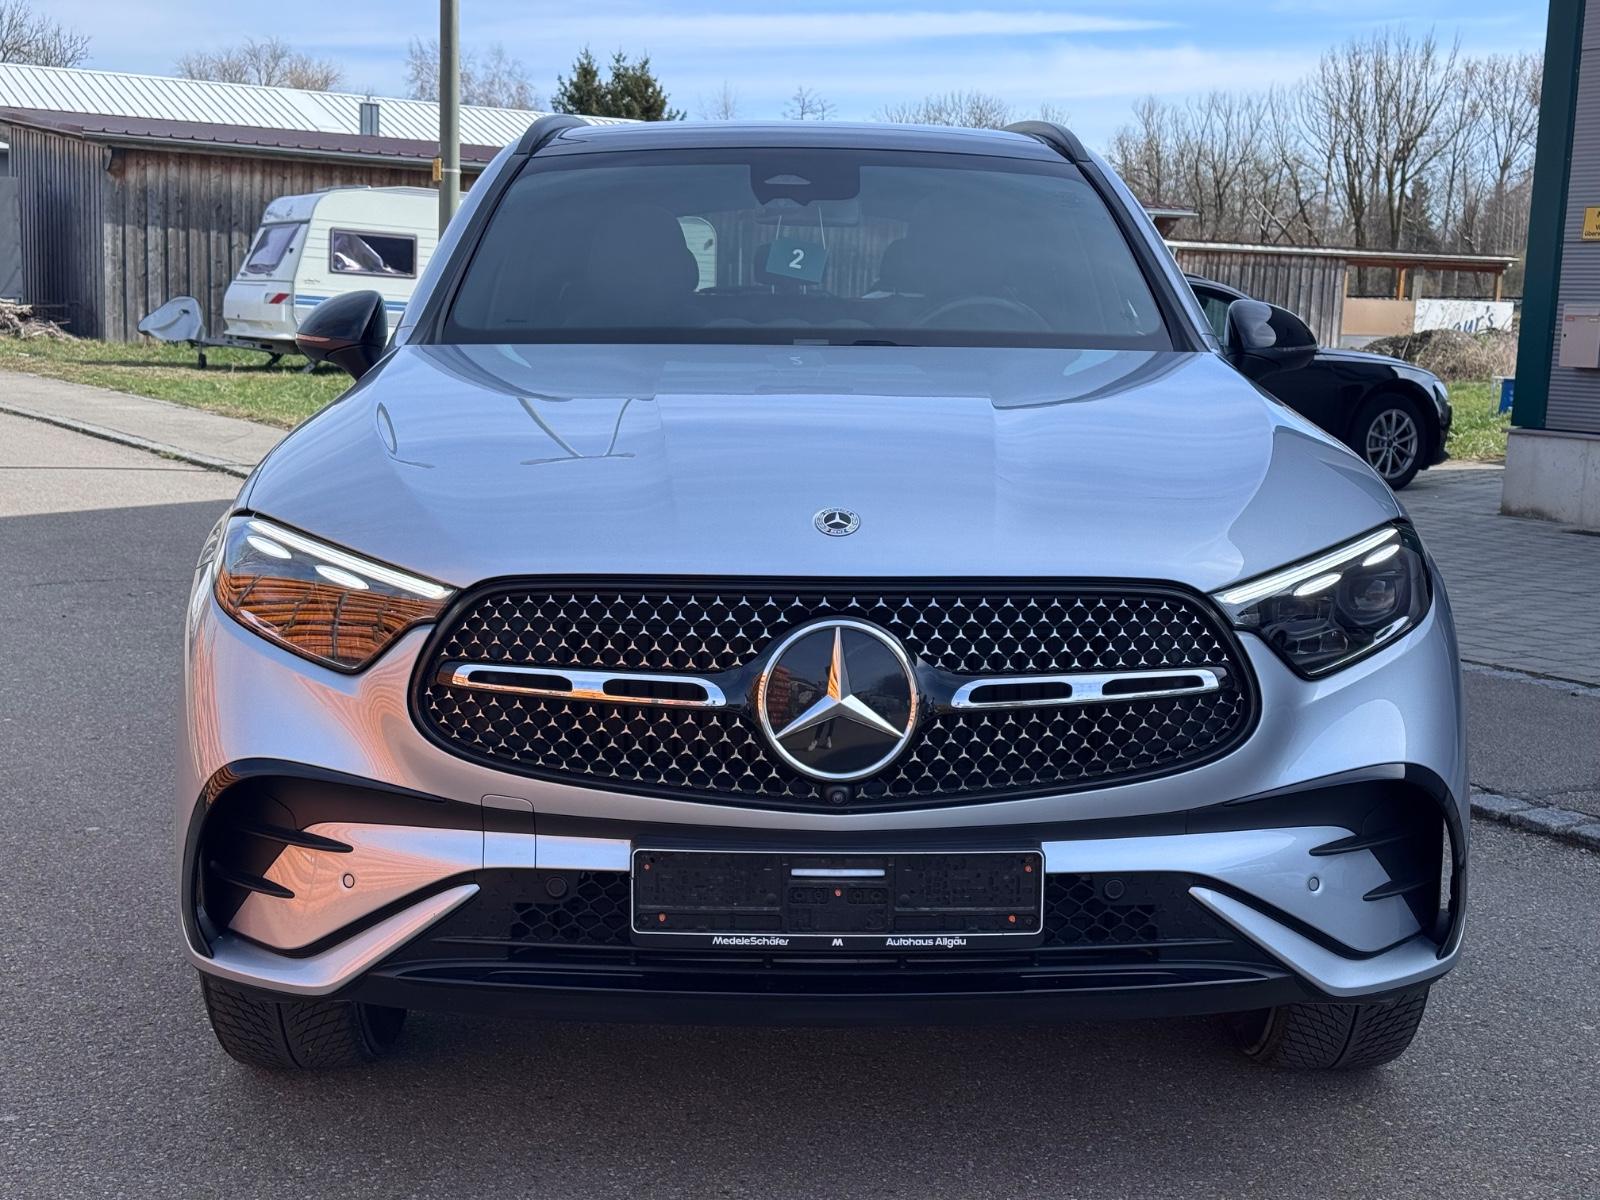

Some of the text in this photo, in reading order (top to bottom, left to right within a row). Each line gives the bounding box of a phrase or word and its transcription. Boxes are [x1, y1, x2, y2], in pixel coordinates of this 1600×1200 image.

[789, 248, 804, 269] 2
[712, 936, 790, 946] MedeleSchäfer
[886, 936, 967, 948] Autohaus Allgäu
